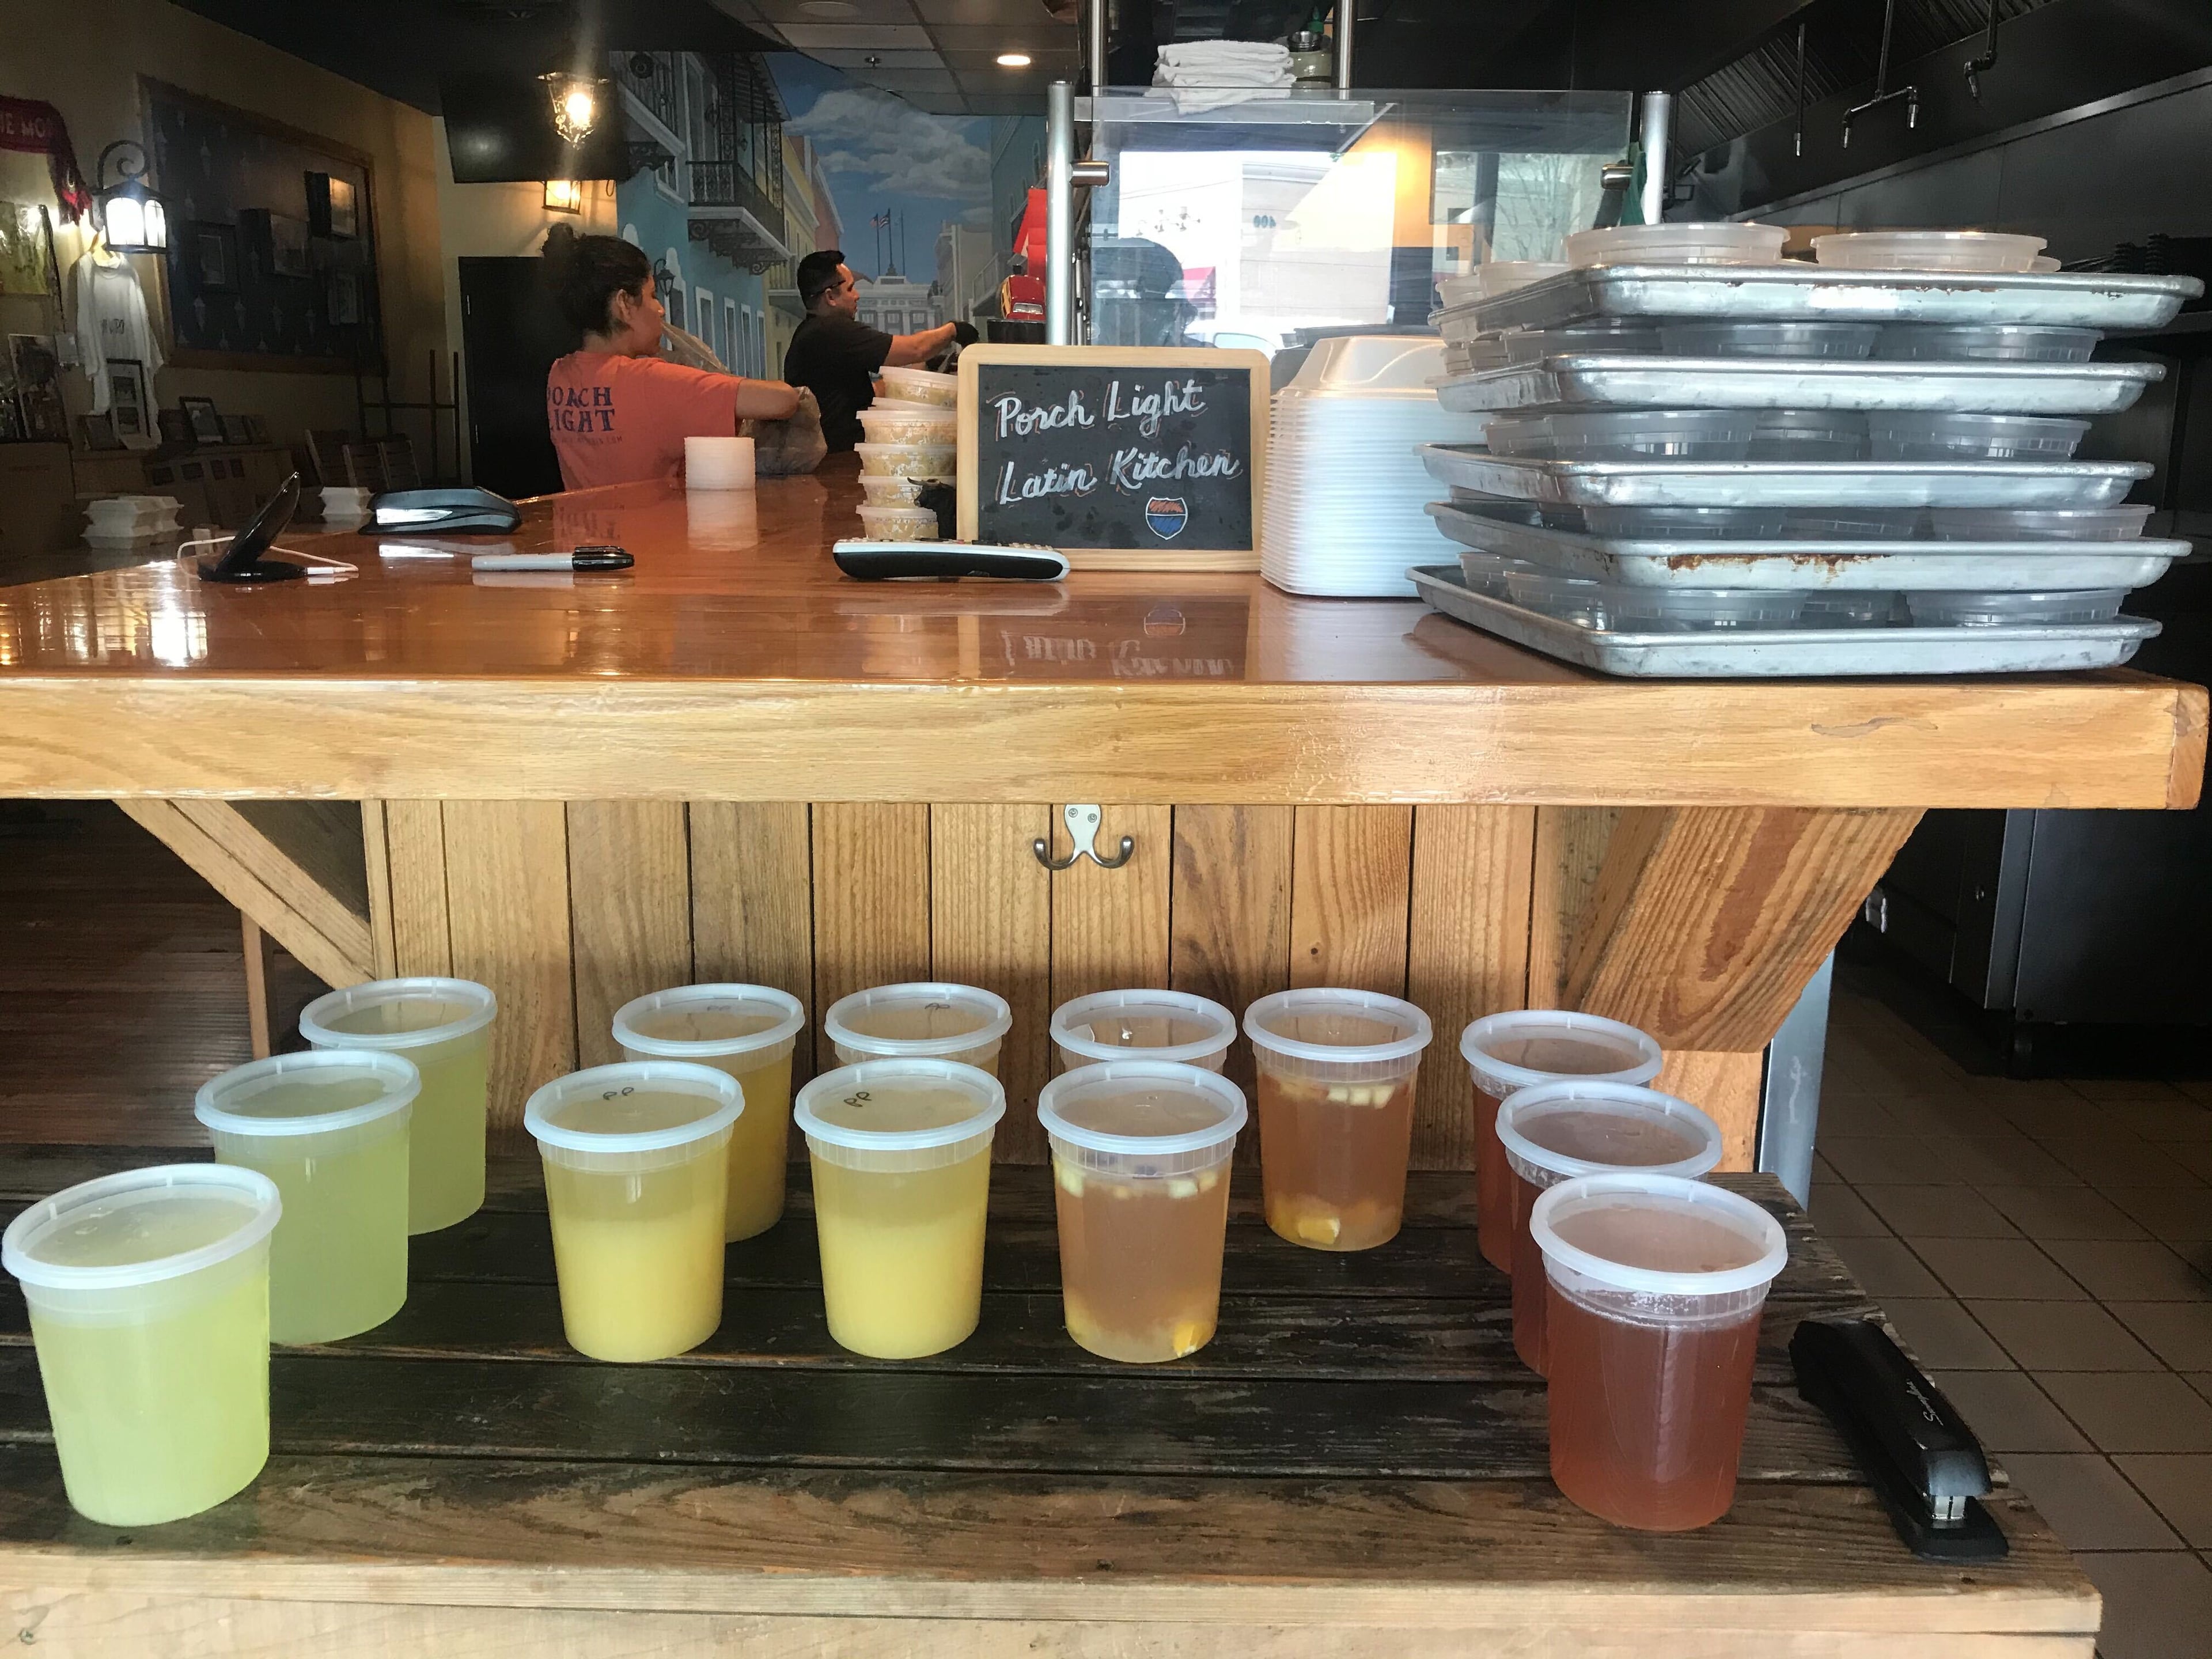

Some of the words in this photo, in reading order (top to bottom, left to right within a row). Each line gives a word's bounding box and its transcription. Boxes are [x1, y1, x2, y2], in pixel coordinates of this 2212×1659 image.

[550, 408, 615, 432] IGHT
[995, 390, 1094, 438] Porch
[1107, 379, 1206, 438] Light
[999, 461, 1097, 505] Latin
[1109, 444, 1240, 490] Kitchen
